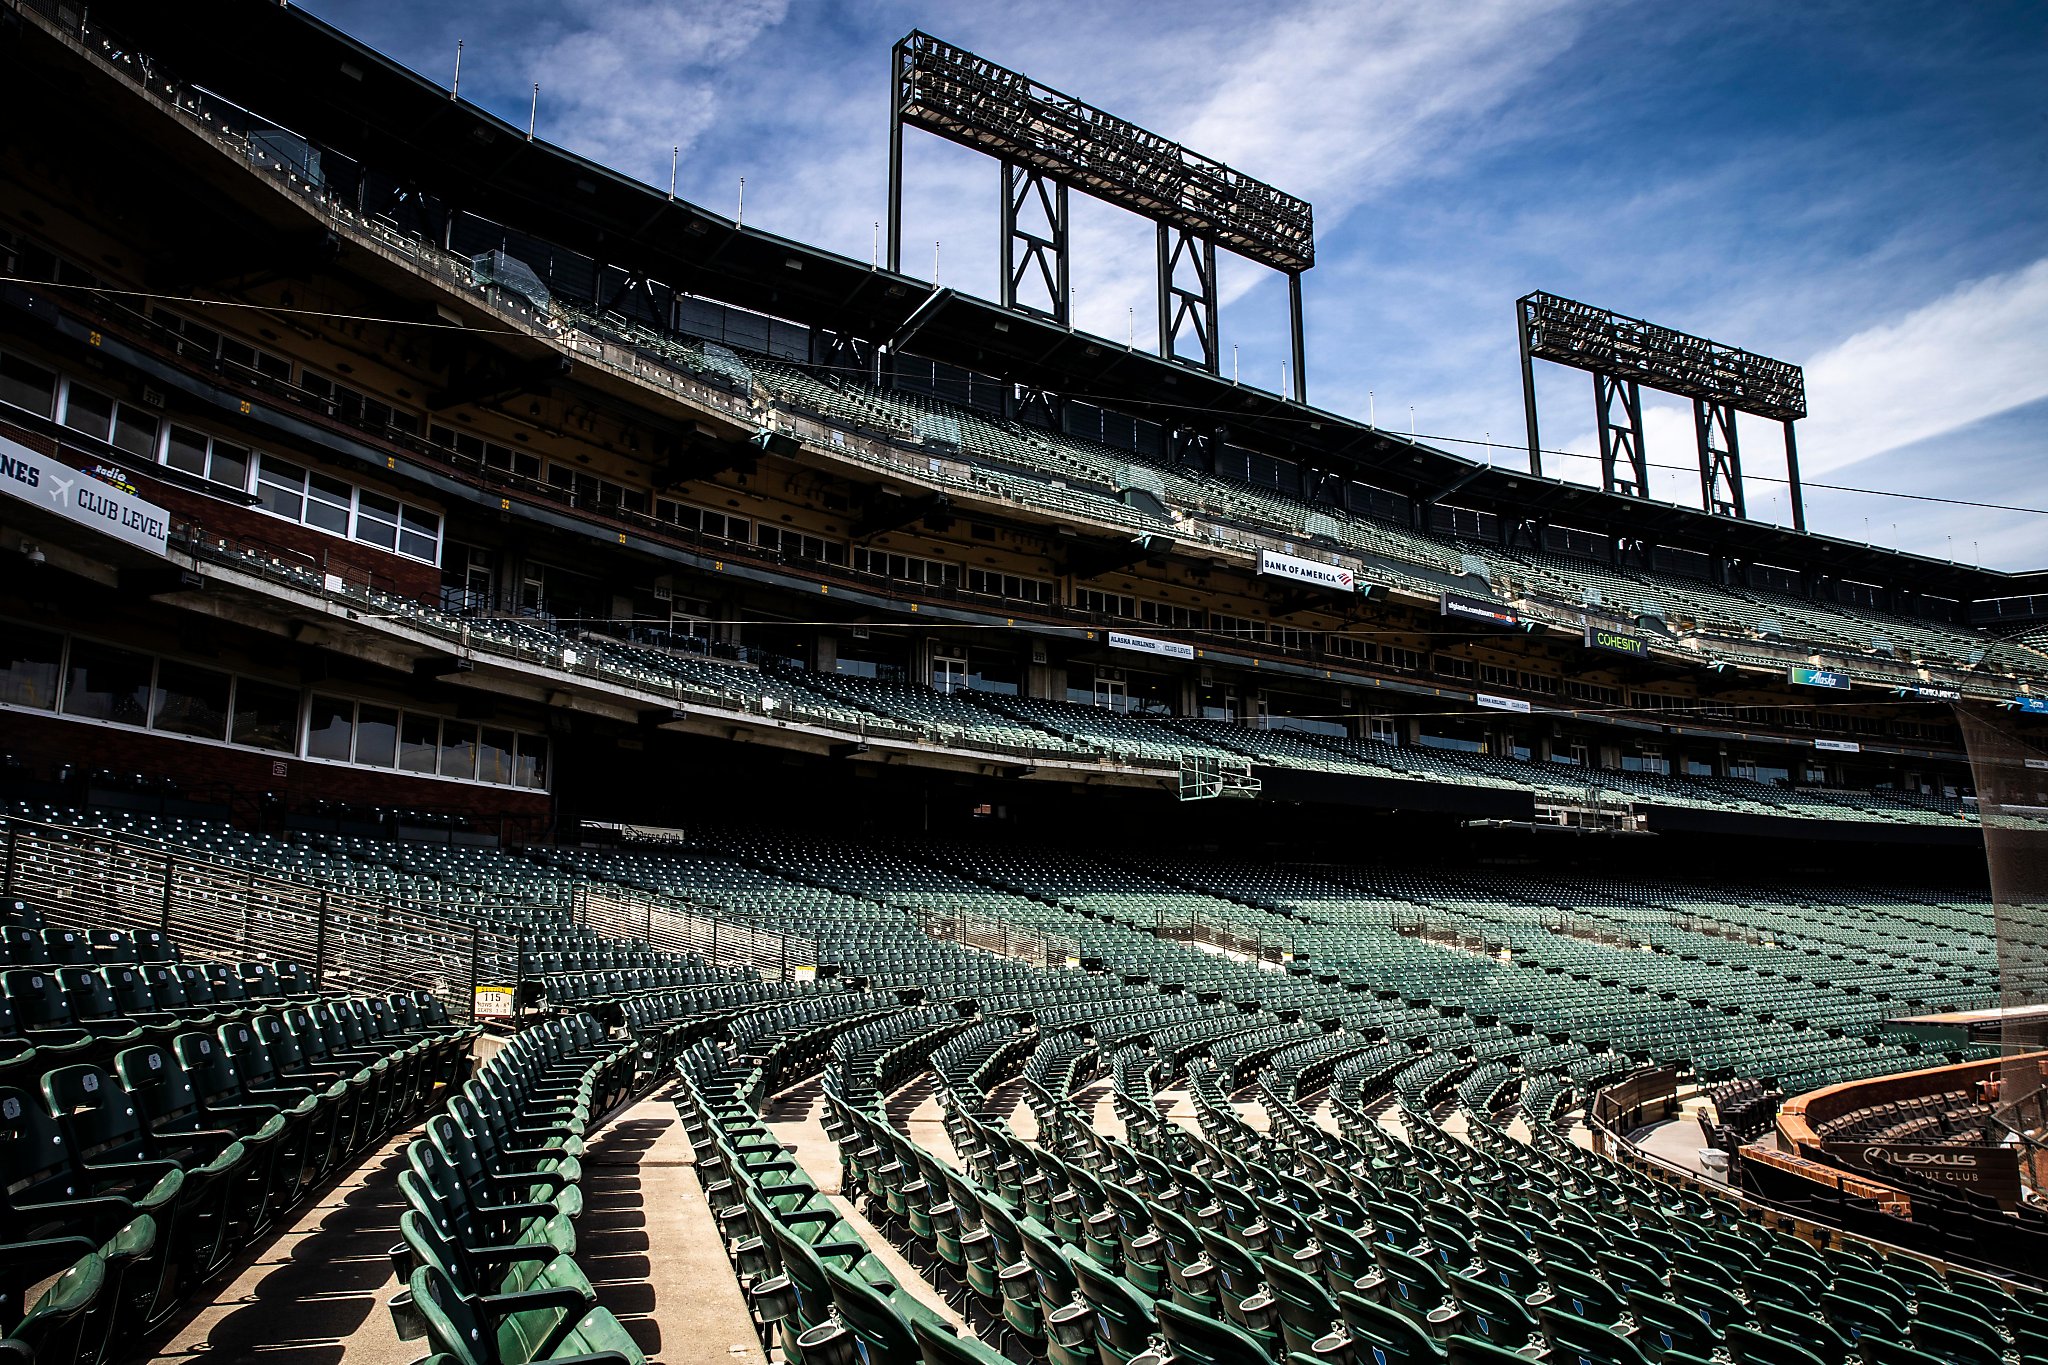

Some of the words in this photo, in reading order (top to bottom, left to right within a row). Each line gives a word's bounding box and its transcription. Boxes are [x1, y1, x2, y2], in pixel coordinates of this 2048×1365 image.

[96, 464, 127, 482] Radio
[78, 488, 118, 521] CLUB
[122, 507, 165, 541] LEVEL
[1264, 560, 1287, 572] BANK
[1288, 565, 1299, 574] OF
[1300, 568, 1336, 583] AMERICA
[1110, 636, 1131, 645] ALASKA
[1132, 640, 1156, 649] AIRLINES
[1178, 647, 1191, 655] LEVEL
[1597, 632, 1641, 653] COHESITY
[1808, 671, 1836, 687] Alaska
[485, 993, 501, 1001] 115
[89, 1077, 93, 1087] 4
[9, 1102, 14, 1115] 3
[1893, 1152, 1977, 1166] LEXUS
[1945, 1172, 1979, 1182] CLUB
